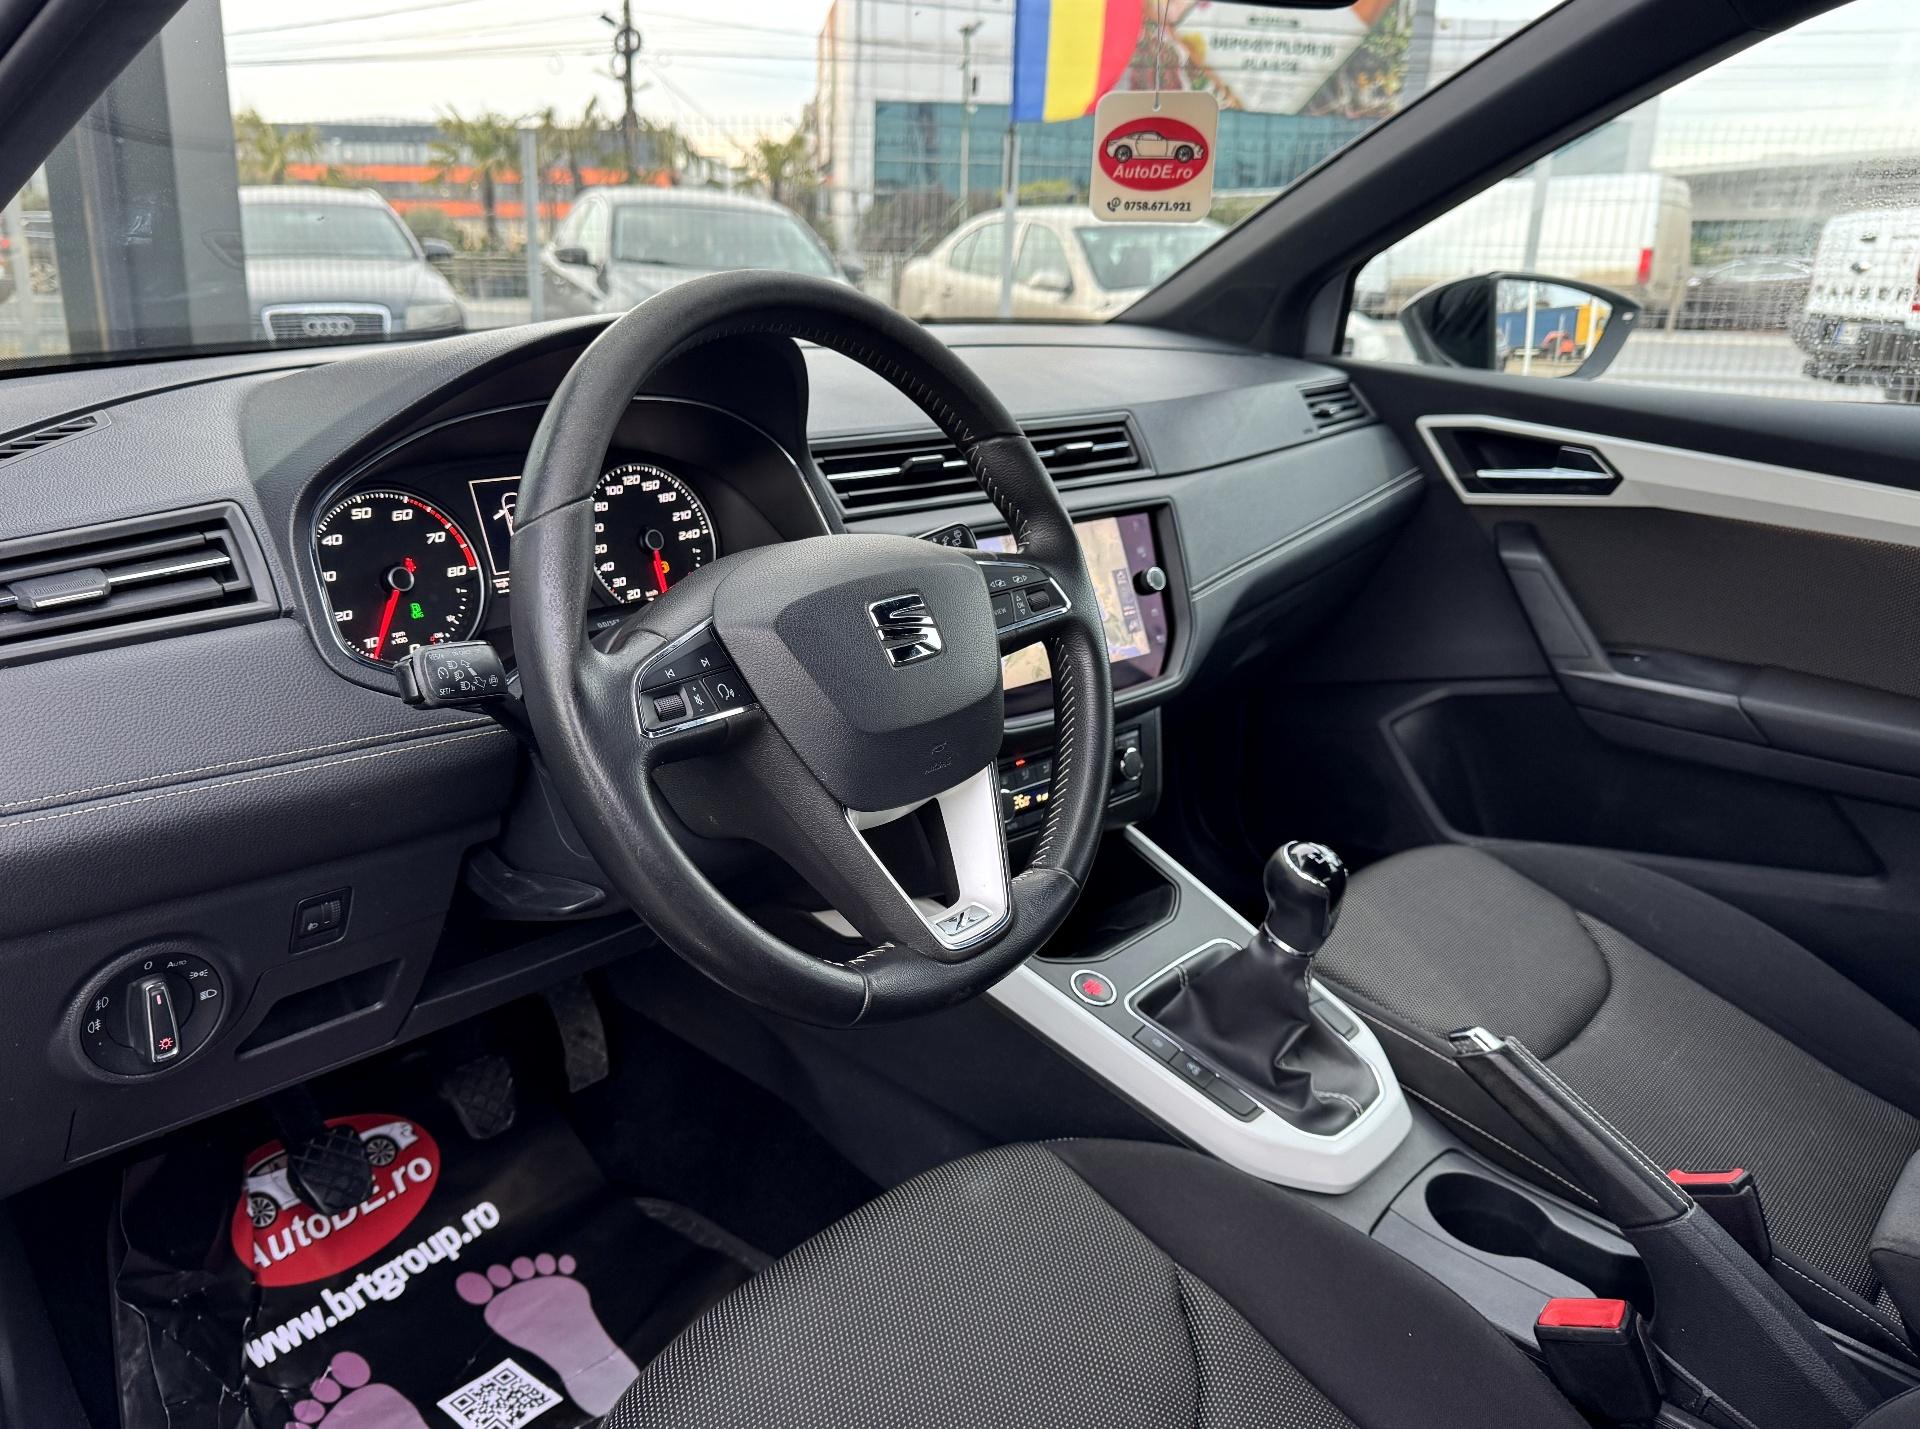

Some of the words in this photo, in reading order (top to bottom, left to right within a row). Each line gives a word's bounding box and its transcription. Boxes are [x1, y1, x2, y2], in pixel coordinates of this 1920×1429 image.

[1112, 164, 1194, 179] AutoDE.ro
[1123, 201, 1192, 212] 0758.671.921
[622, 474, 641, 486] 120
[641, 479, 660, 492] 150
[605, 484, 624, 496] 100
[594, 501, 609, 512] 80
[351, 507, 372, 520] 50
[391, 508, 413, 522] 60
[672, 509, 692, 522] 210
[321, 533, 343, 546] 40
[425, 531, 446, 545] 70
[678, 528, 700, 541] 240
[446, 565, 467, 578] 80
[600, 561, 615, 572] 40
[612, 576, 627, 588] 30
[626, 588, 641, 600] 20
[334, 609, 353, 622] 20
[246, 1201, 501, 1369] www.brtgroup.ro
